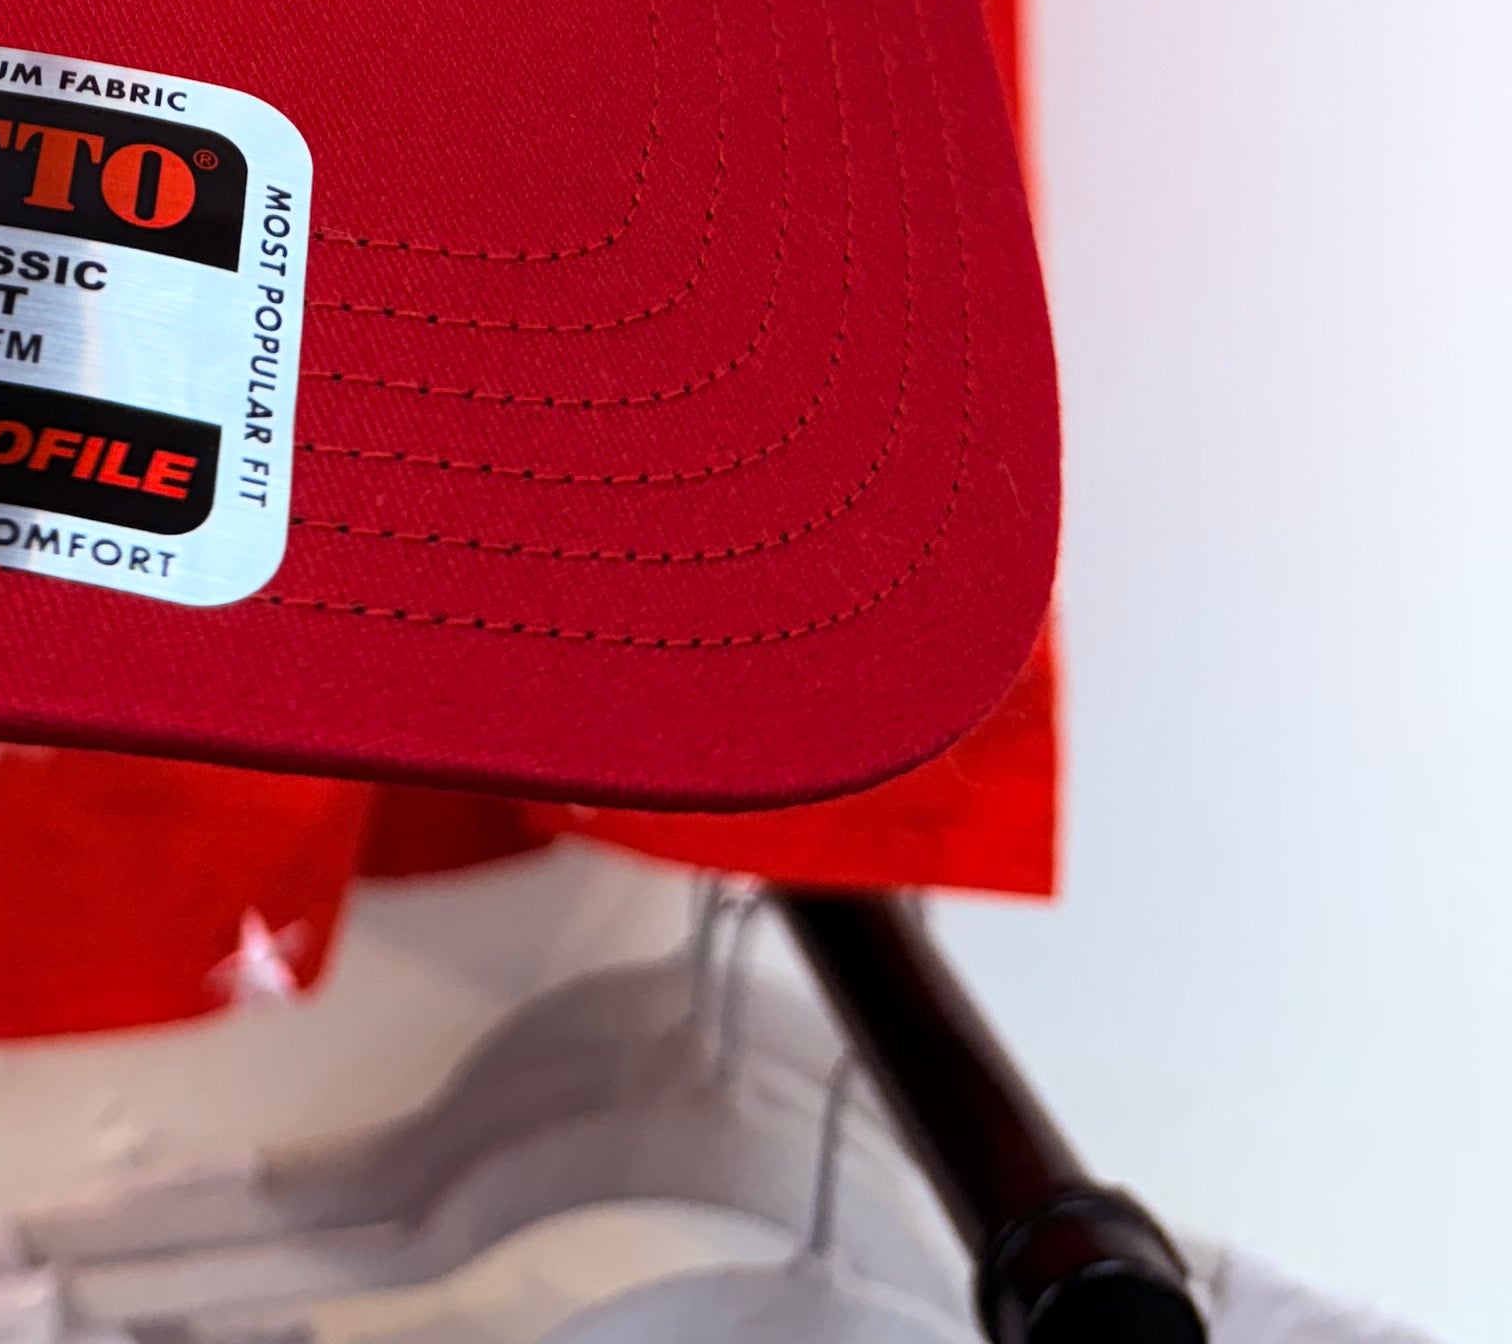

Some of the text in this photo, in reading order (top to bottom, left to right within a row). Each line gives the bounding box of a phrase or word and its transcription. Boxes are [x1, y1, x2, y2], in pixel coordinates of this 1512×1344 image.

[58, 69, 190, 113] FABRIC
[238, 184, 293, 507] MOST POPULAR FIT
